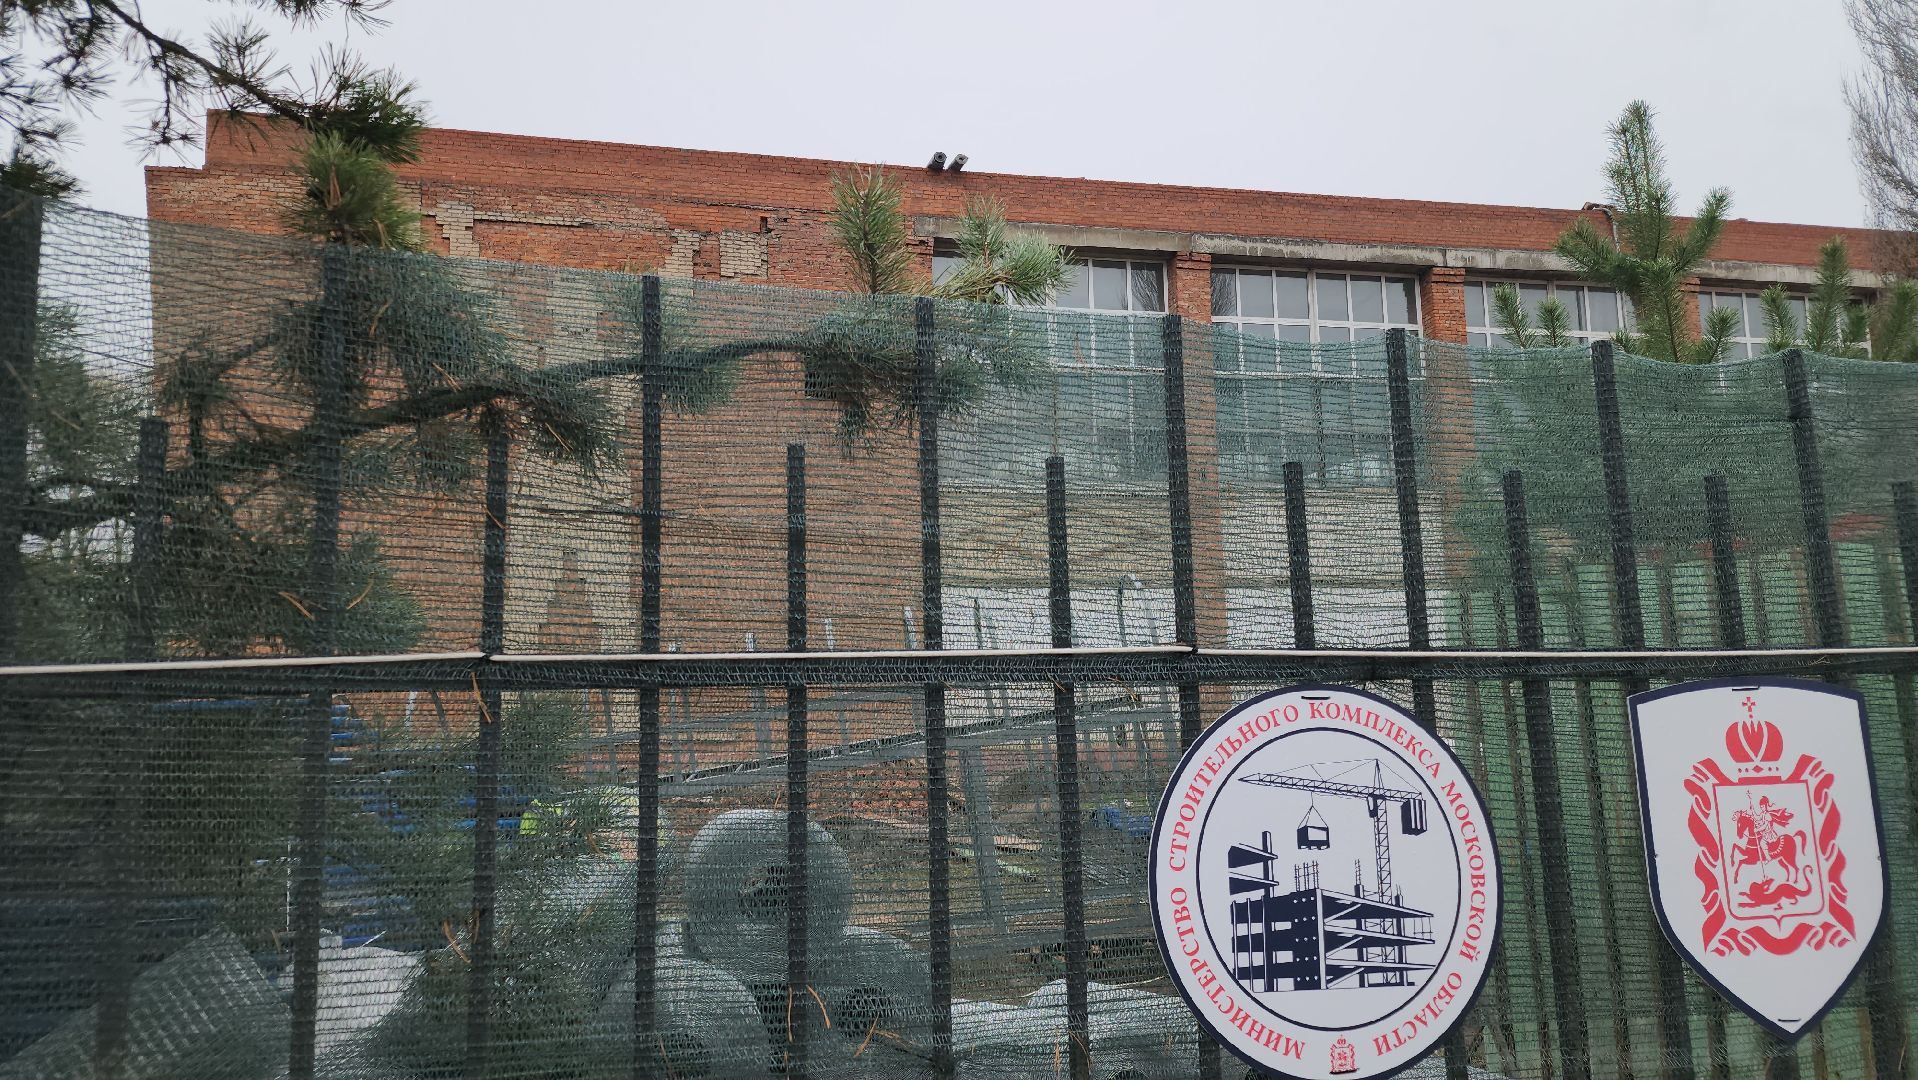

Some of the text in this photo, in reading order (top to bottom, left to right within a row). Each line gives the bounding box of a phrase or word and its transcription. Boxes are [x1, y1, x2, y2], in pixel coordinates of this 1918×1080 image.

[1168, 700, 1487, 1061] МИНИСТЕРСТВО СТРОИТЕЛЬНОГО КОМПЛЕКСА МОСКОВСКОЙ ОБЛАСТИ
